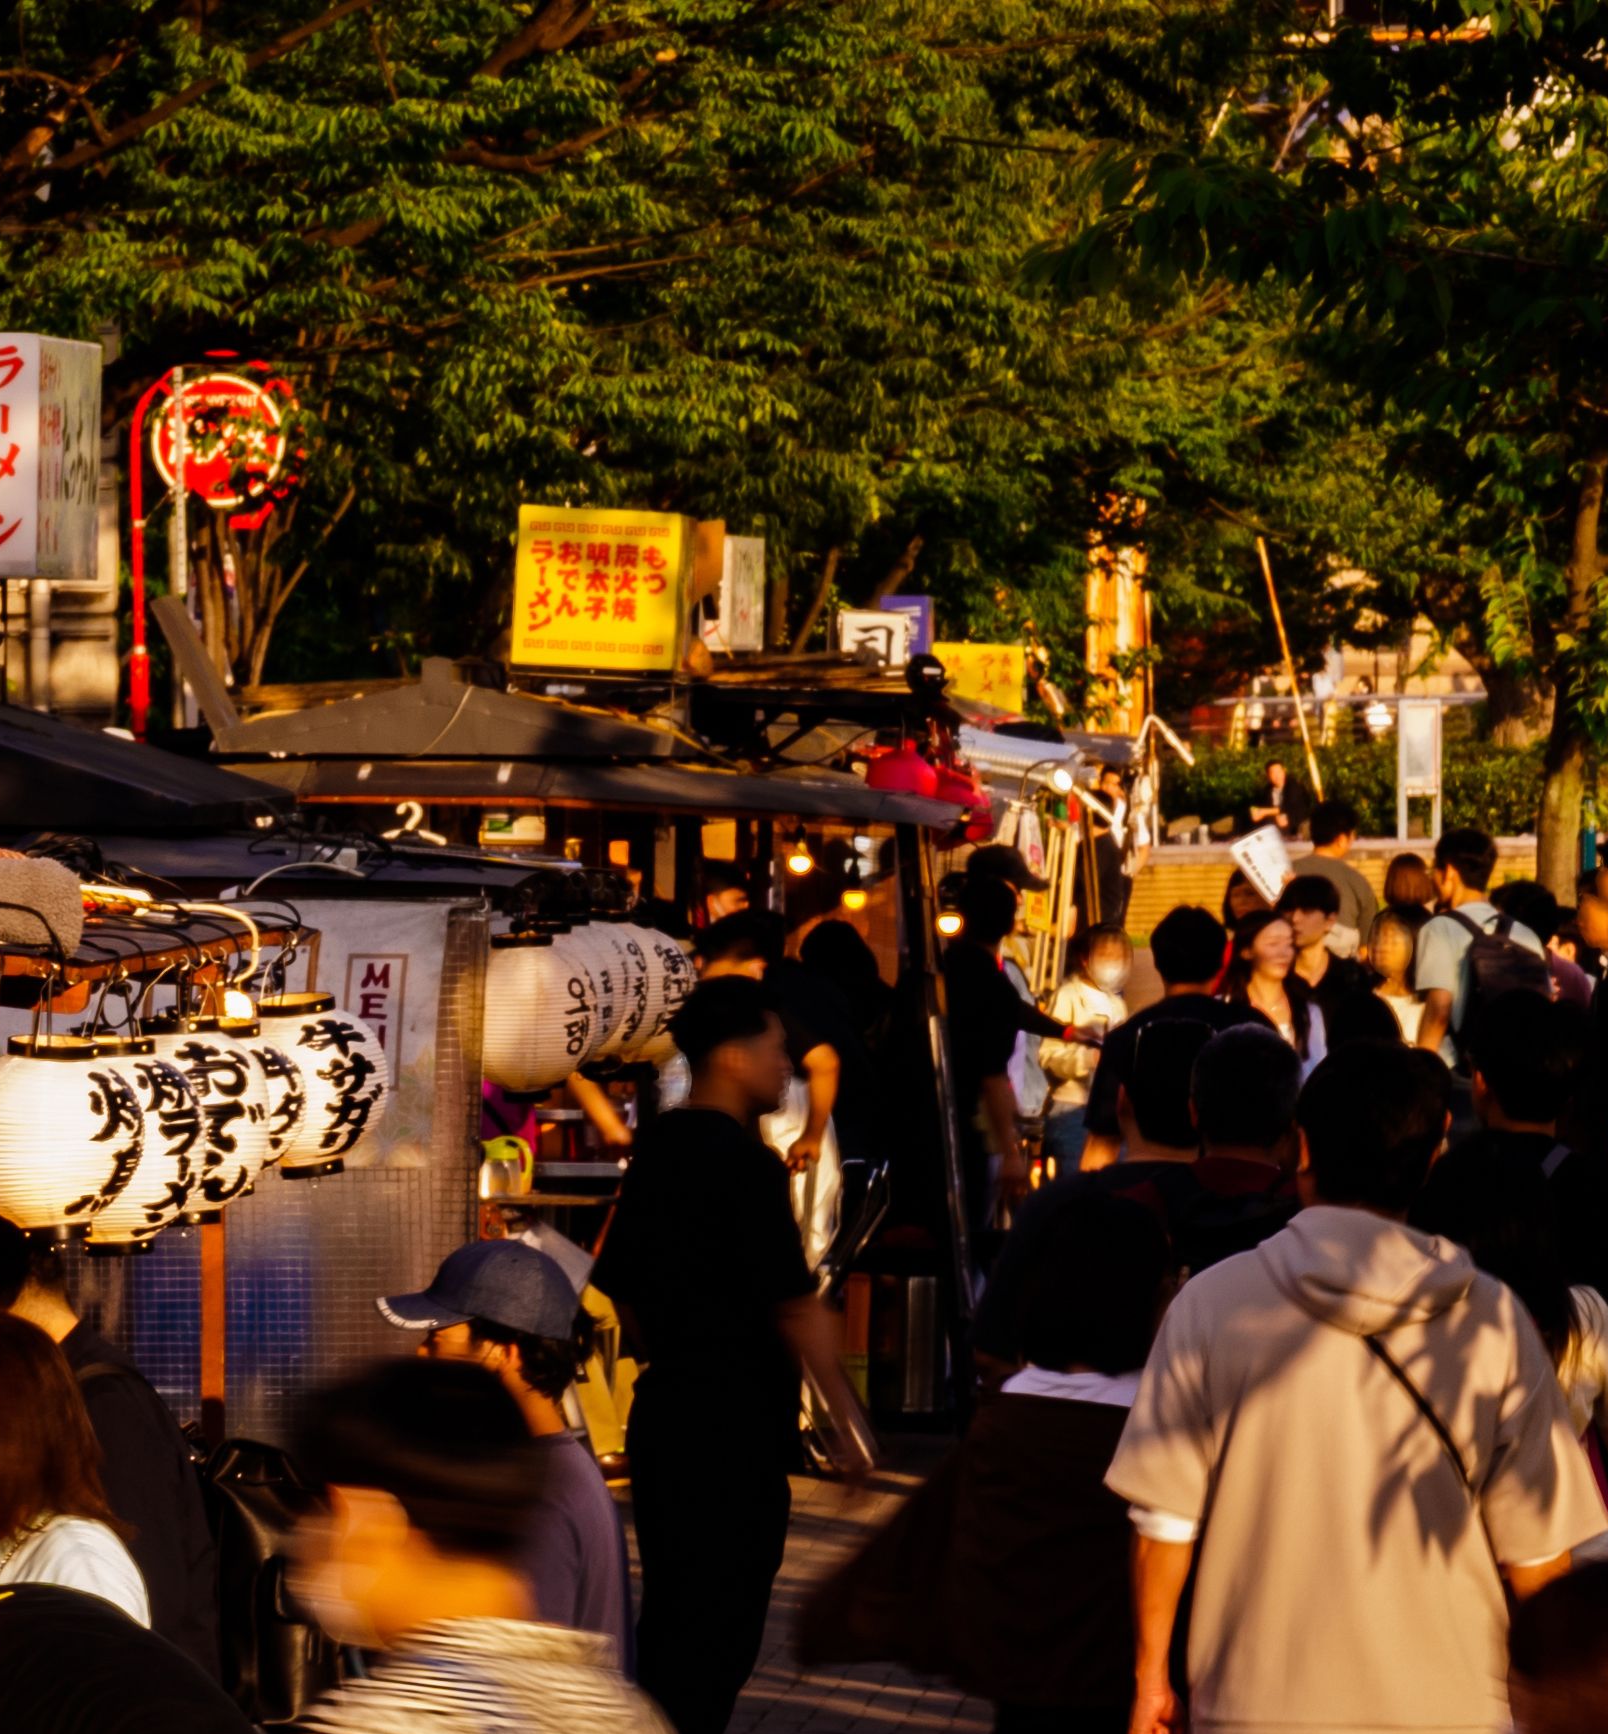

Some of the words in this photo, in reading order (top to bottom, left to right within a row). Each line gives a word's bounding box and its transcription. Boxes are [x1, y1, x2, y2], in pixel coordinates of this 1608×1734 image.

[528, 540, 554, 632] ラーメン
[555, 541, 582, 617] おでん
[584, 542, 611, 621] 明太子
[612, 544, 639, 622] 炭火焼
[643, 545, 667, 595] もつ
